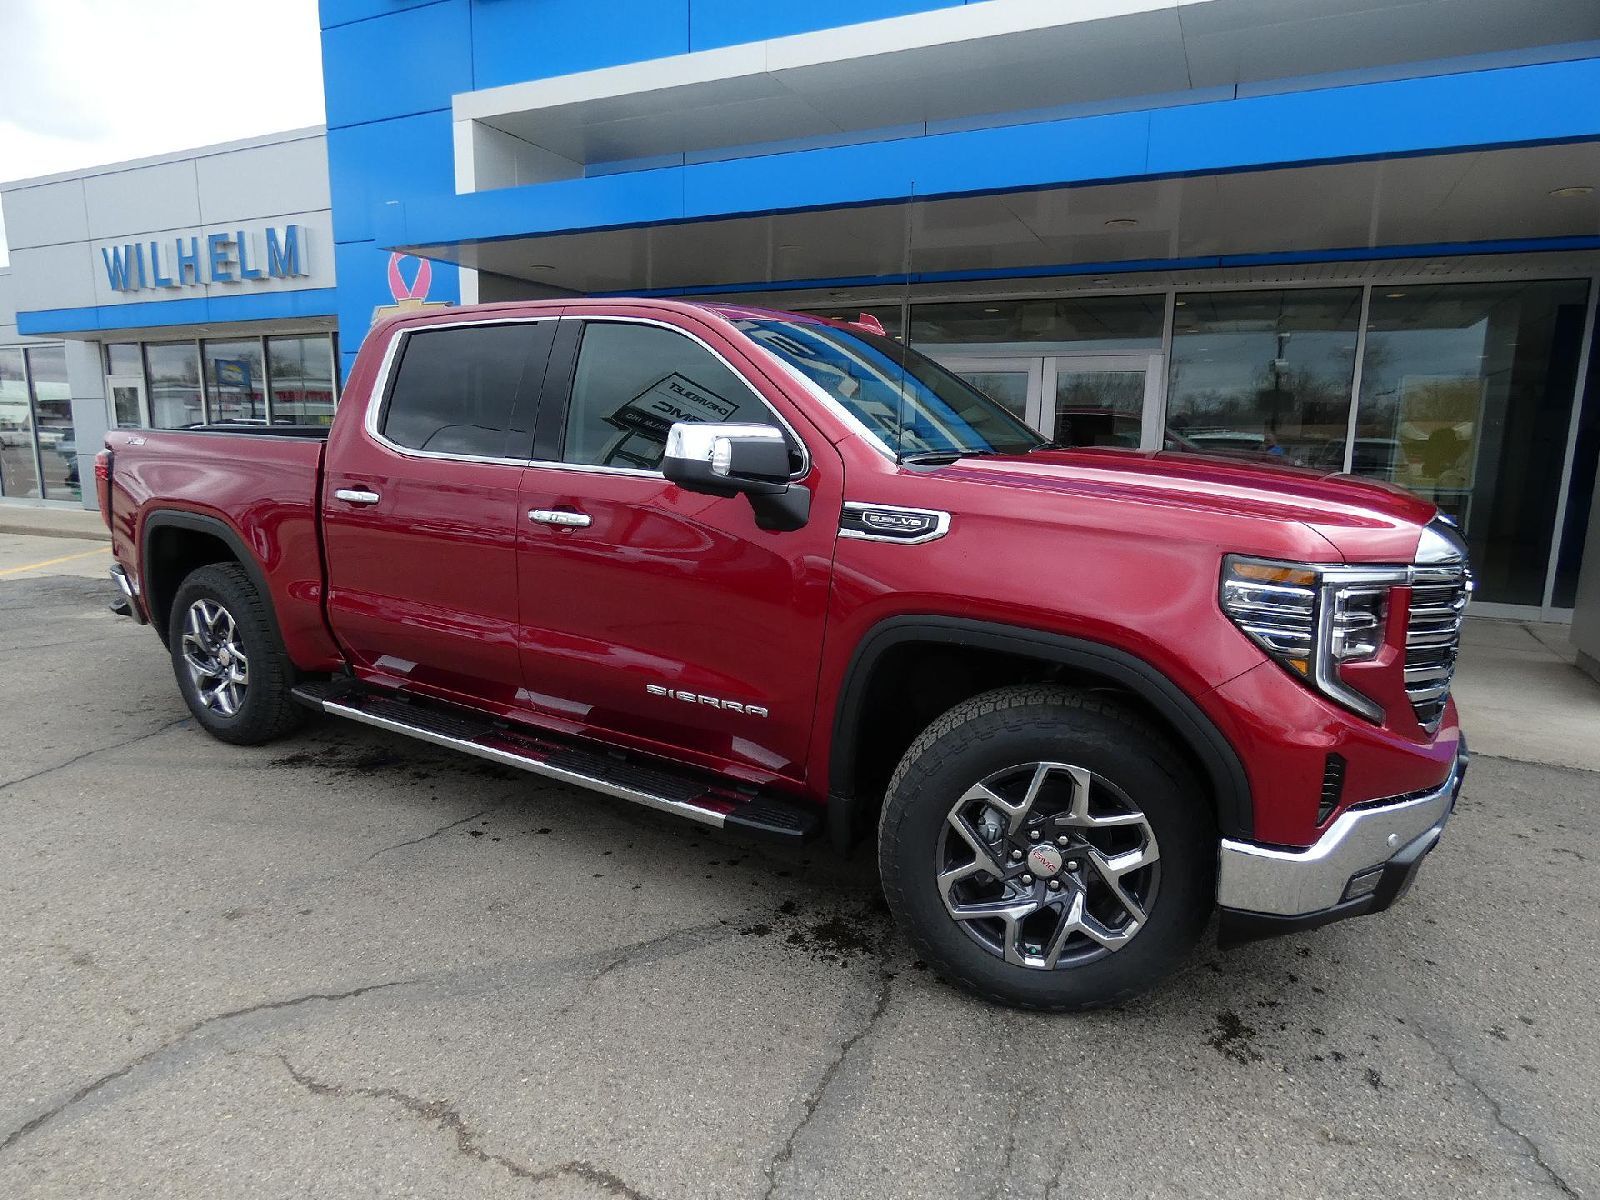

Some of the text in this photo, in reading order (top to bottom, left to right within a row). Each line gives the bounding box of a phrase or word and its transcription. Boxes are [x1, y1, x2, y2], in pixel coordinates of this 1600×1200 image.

[102, 225, 304, 291] WILHELM
[646, 684, 769, 718] SIERRA
[1033, 851, 1056, 872] GMC
